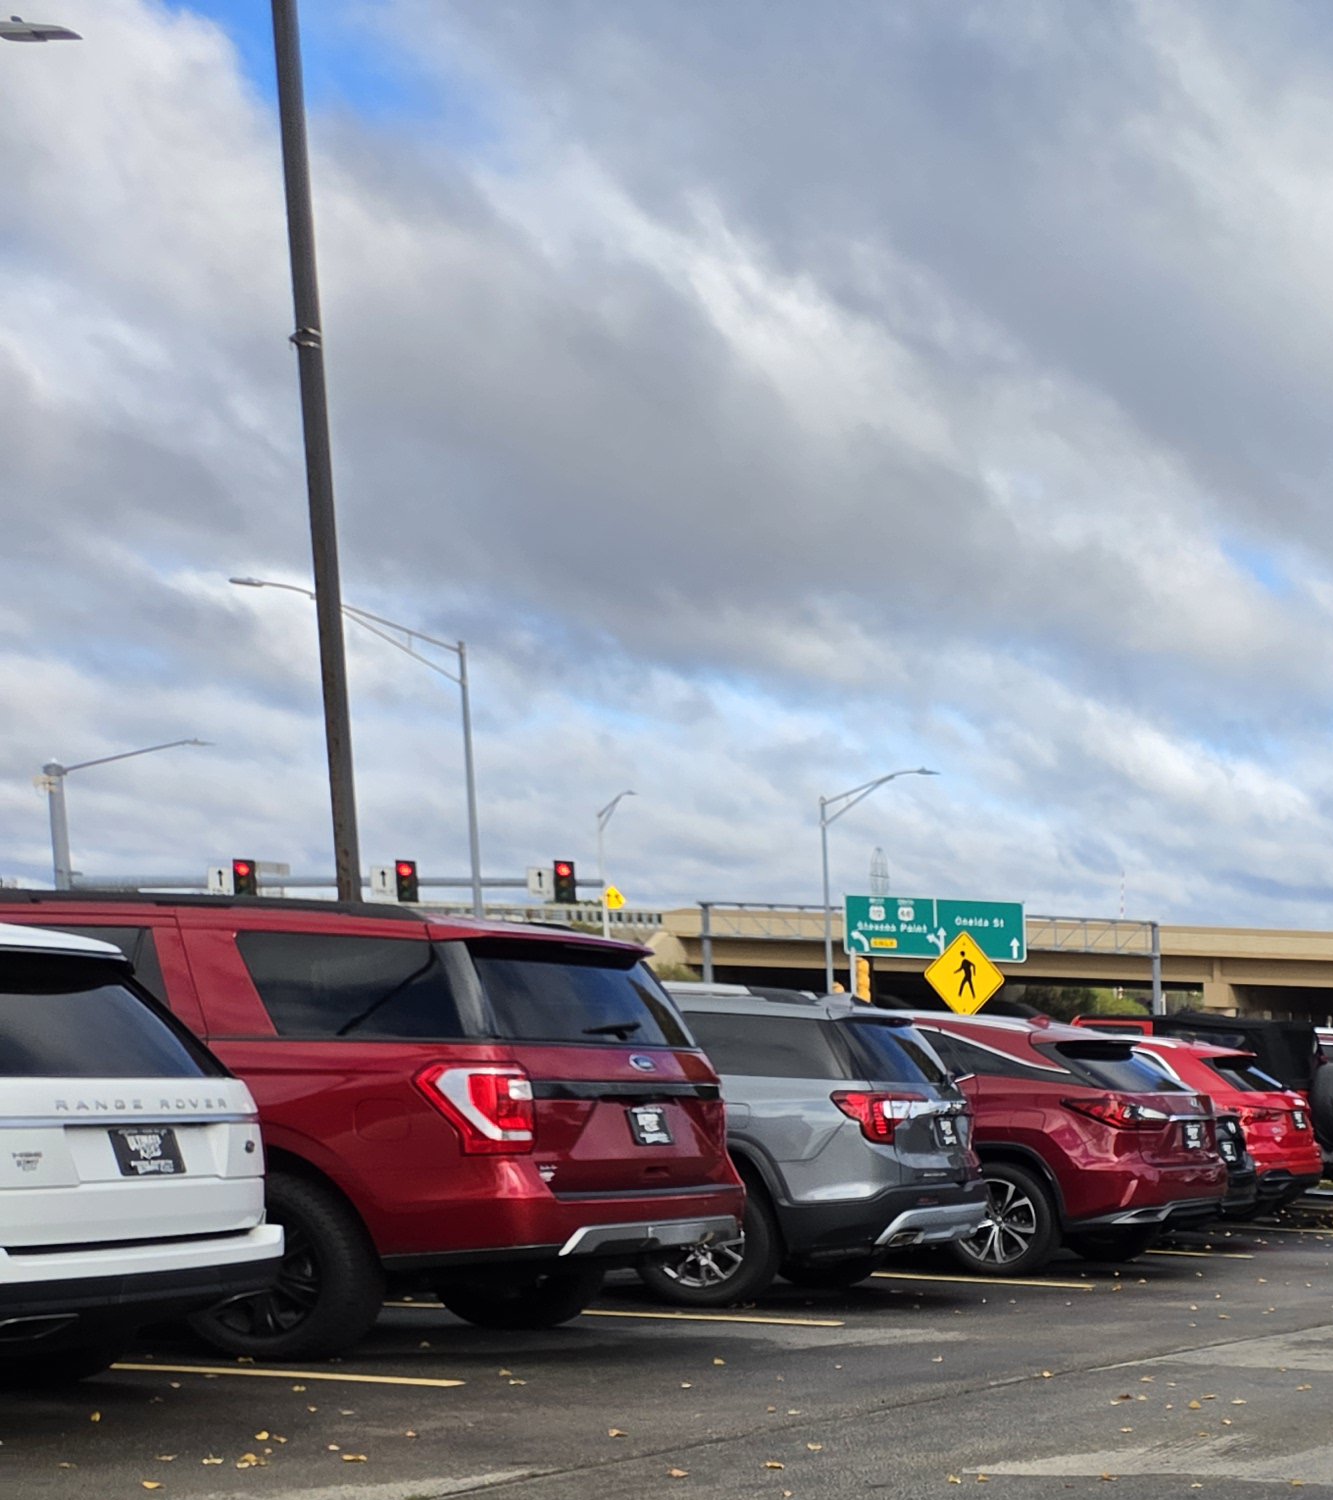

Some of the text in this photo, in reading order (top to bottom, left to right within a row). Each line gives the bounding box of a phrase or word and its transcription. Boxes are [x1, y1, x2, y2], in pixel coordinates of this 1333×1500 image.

[955, 916, 1004, 928] Oneida St
[900, 923, 928, 934] Point
[55, 1098, 227, 1110] RANGE ROVER
